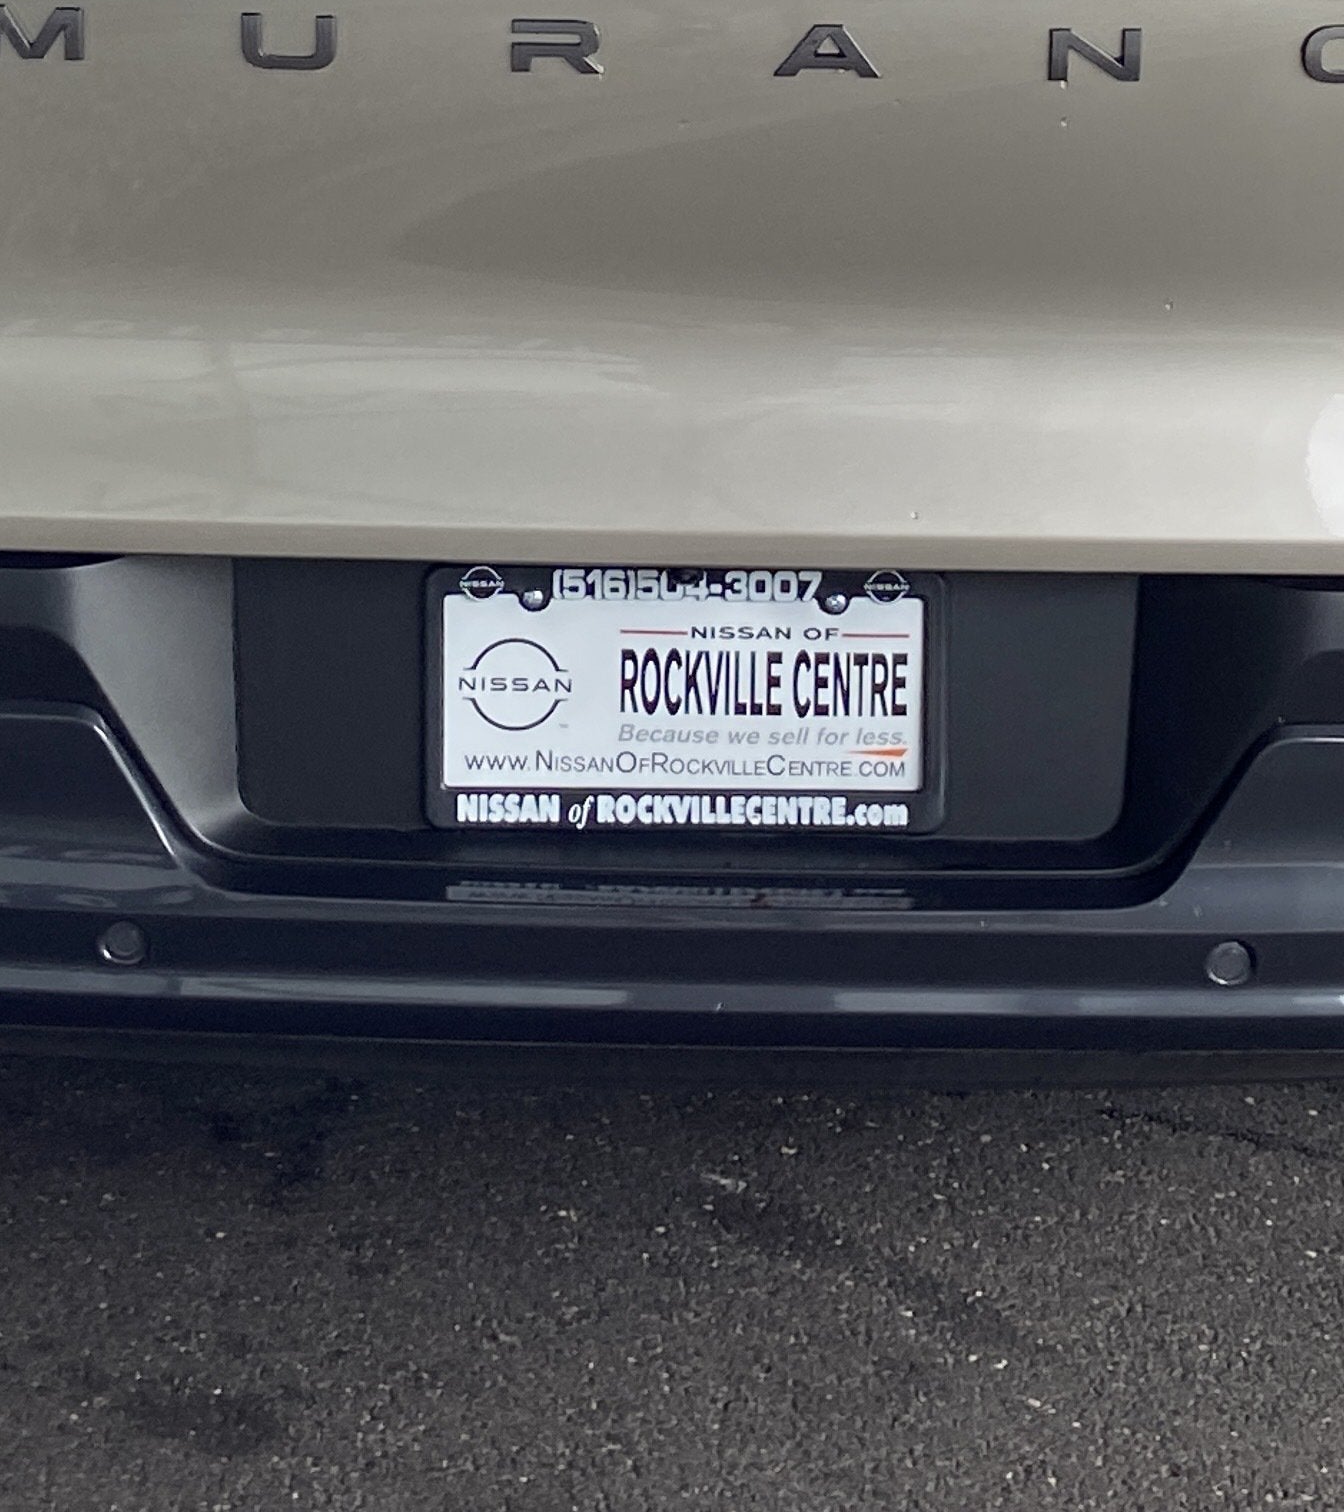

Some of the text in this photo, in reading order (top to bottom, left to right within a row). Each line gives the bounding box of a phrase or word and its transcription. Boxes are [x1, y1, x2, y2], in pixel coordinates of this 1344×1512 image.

[691, 626, 840, 641] NISSAN OF
[458, 677, 573, 693] NISSAN
[619, 647, 909, 718] ROCKVILLE CENTRE
[618, 724, 908, 746] Because we sell for less.
[457, 793, 909, 830] NISSAN of ROCKVILLECENTRE.com
